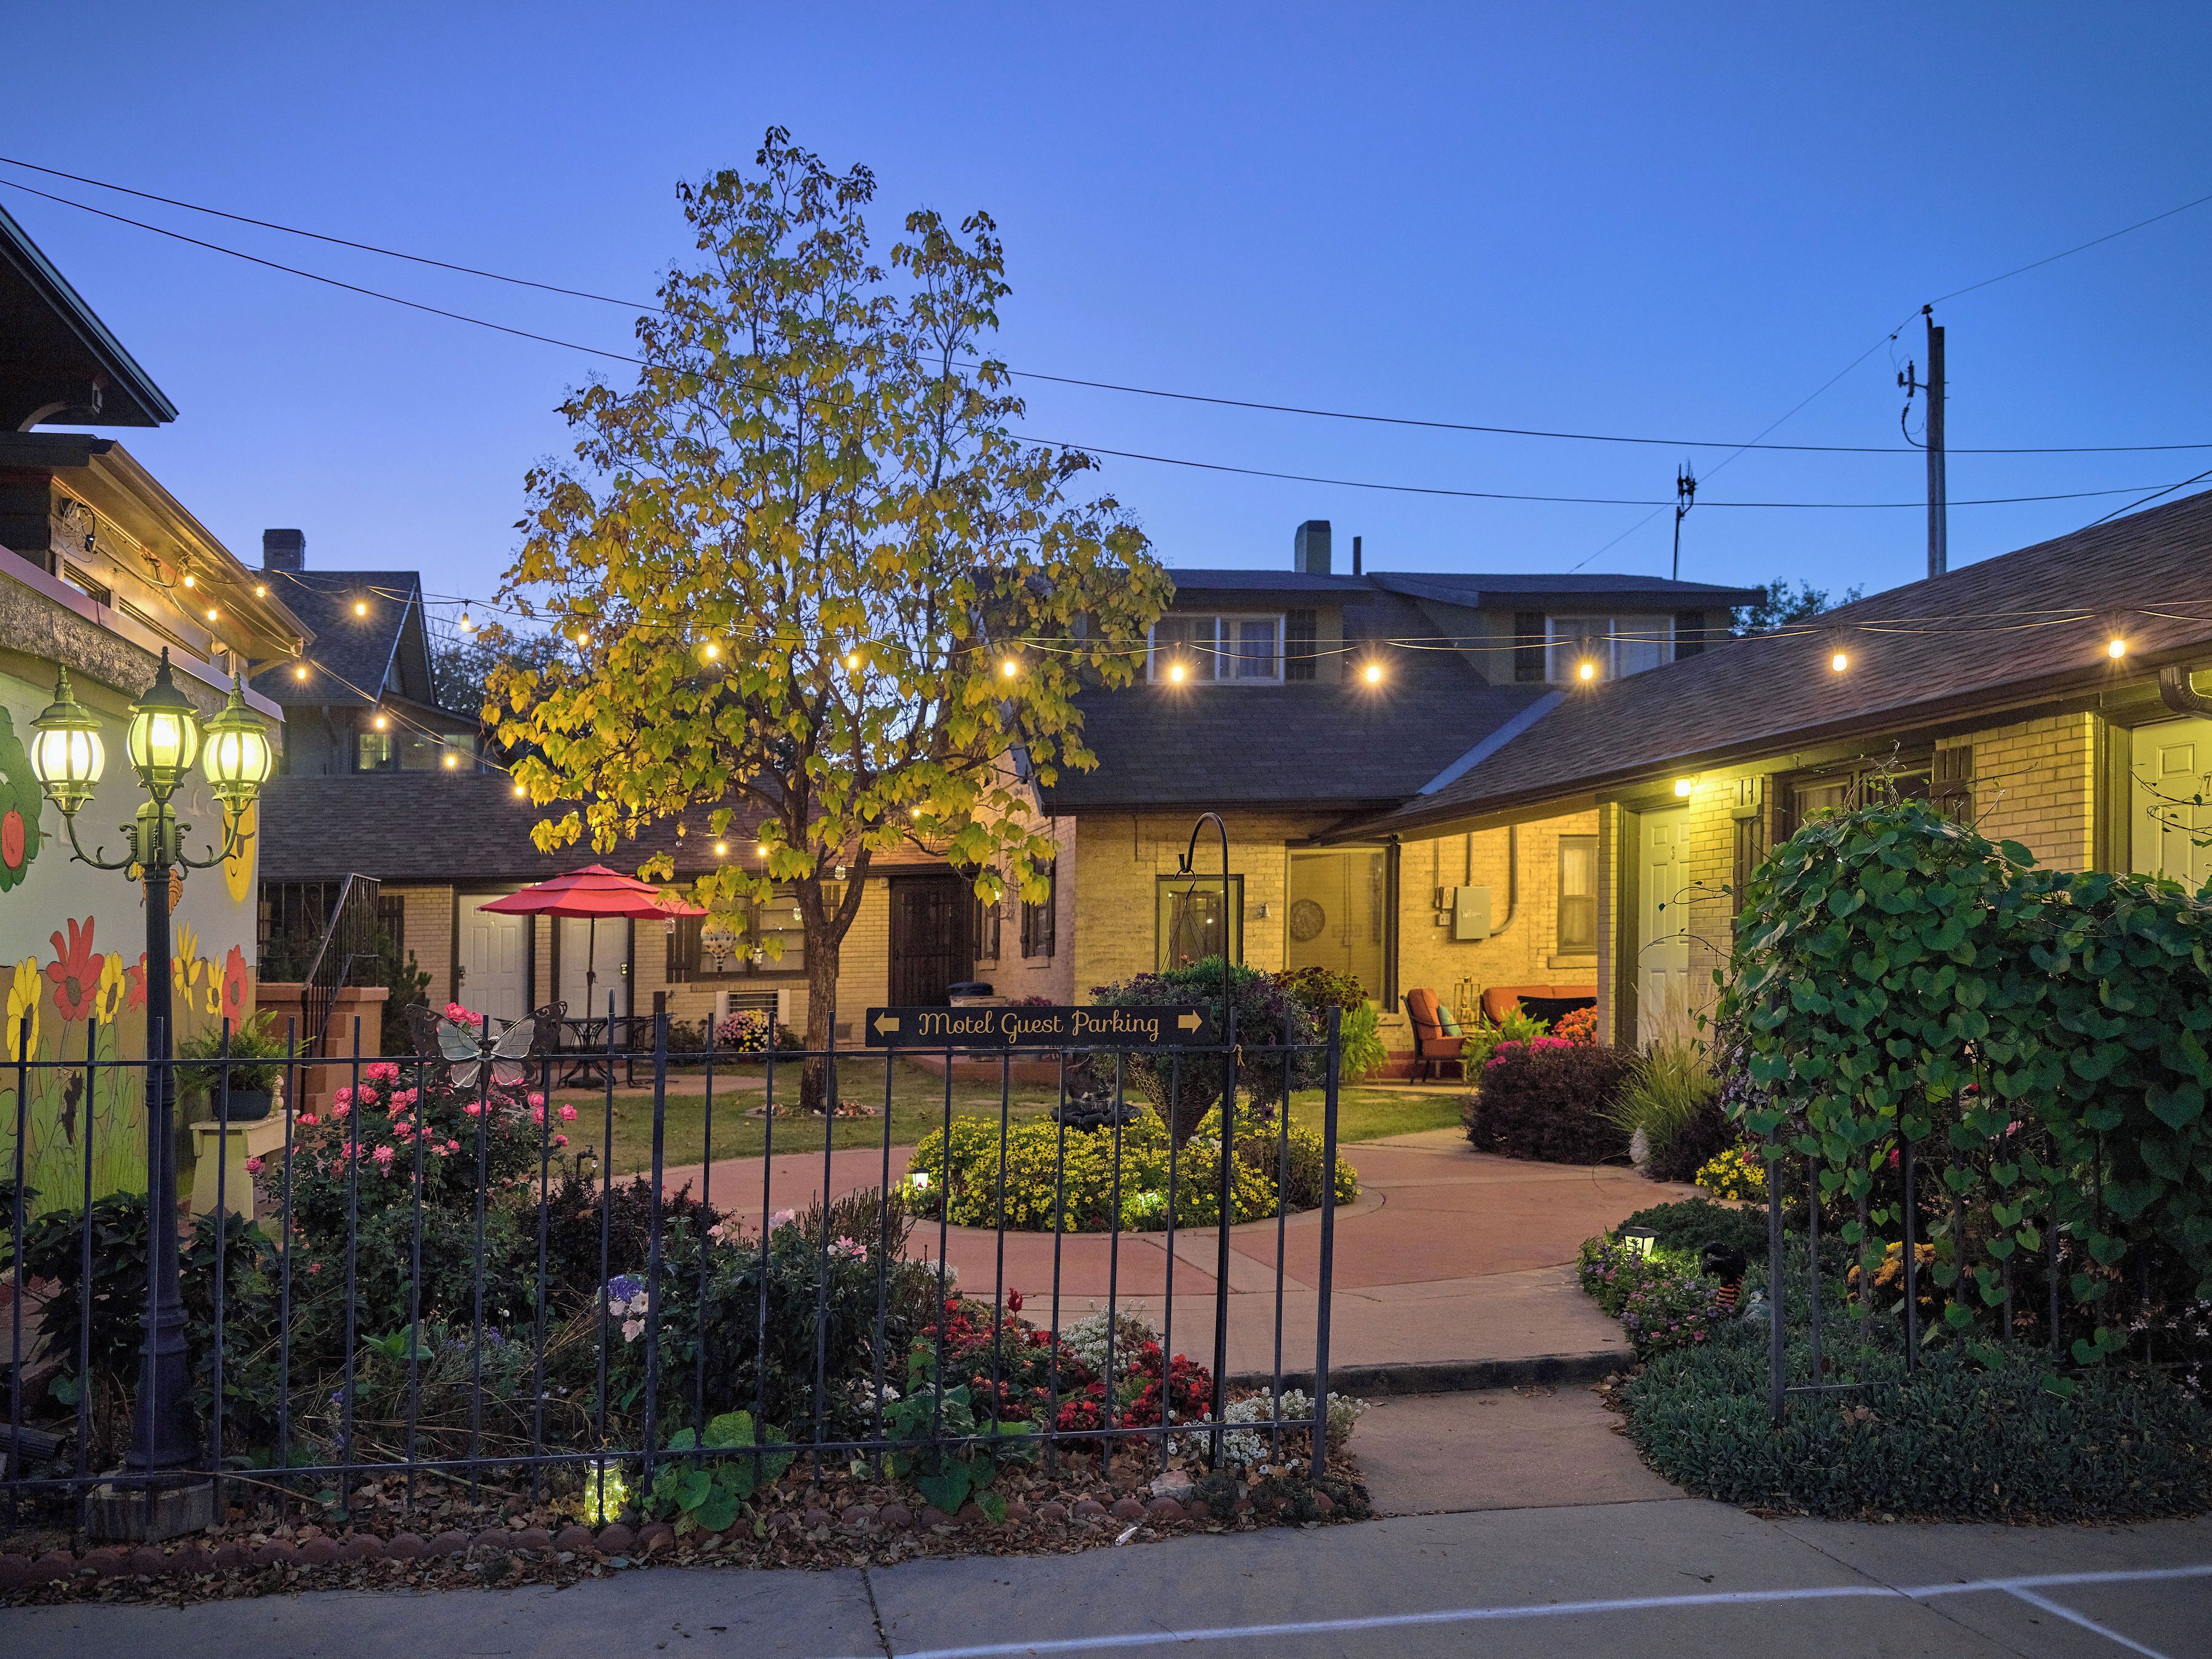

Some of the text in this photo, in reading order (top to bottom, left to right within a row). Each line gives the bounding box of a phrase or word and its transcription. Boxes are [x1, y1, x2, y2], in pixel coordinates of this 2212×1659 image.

[2203, 775, 2211, 796] 7
[919, 1009, 1159, 1043] Motel Guest Parking
